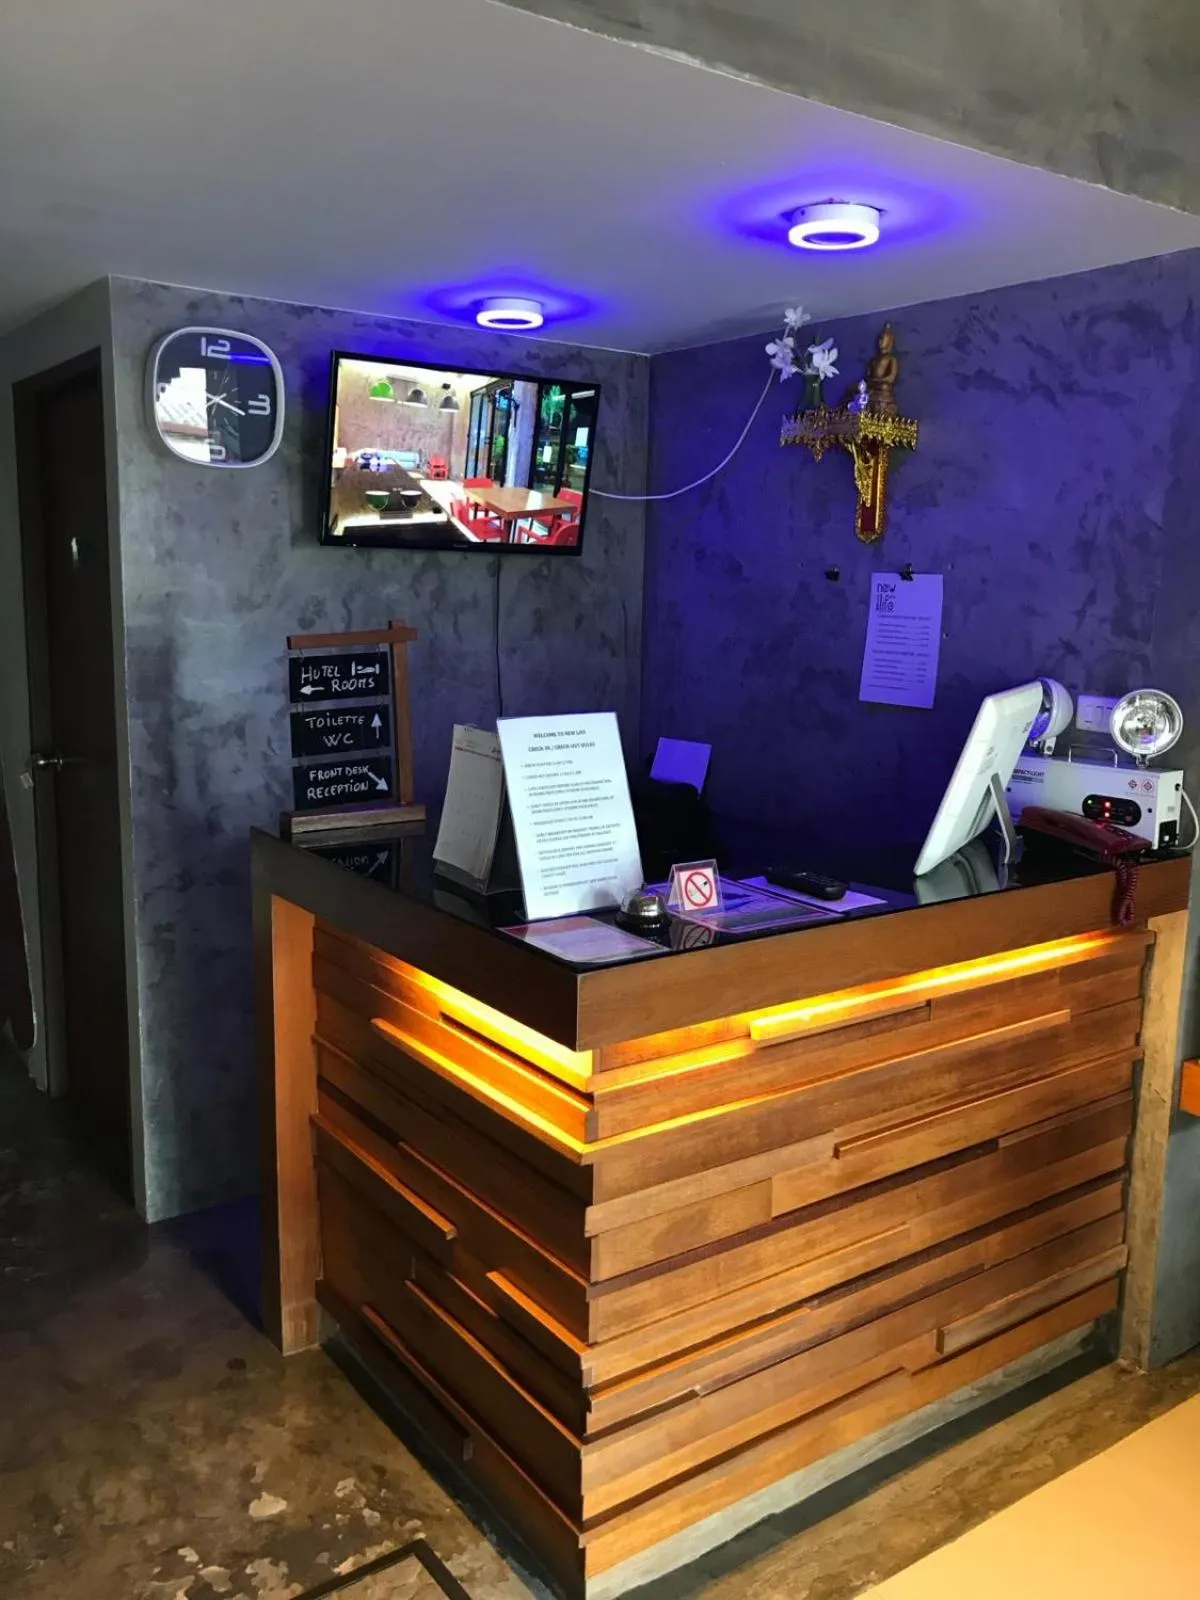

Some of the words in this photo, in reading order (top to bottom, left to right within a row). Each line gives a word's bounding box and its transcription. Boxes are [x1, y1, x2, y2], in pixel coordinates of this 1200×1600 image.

[201, 337, 230, 359] 12
[248, 394, 271, 415] 3
[323, 733, 354, 747] WC
[309, 767, 342, 781] FRONT
[345, 765, 369, 776] DESK
